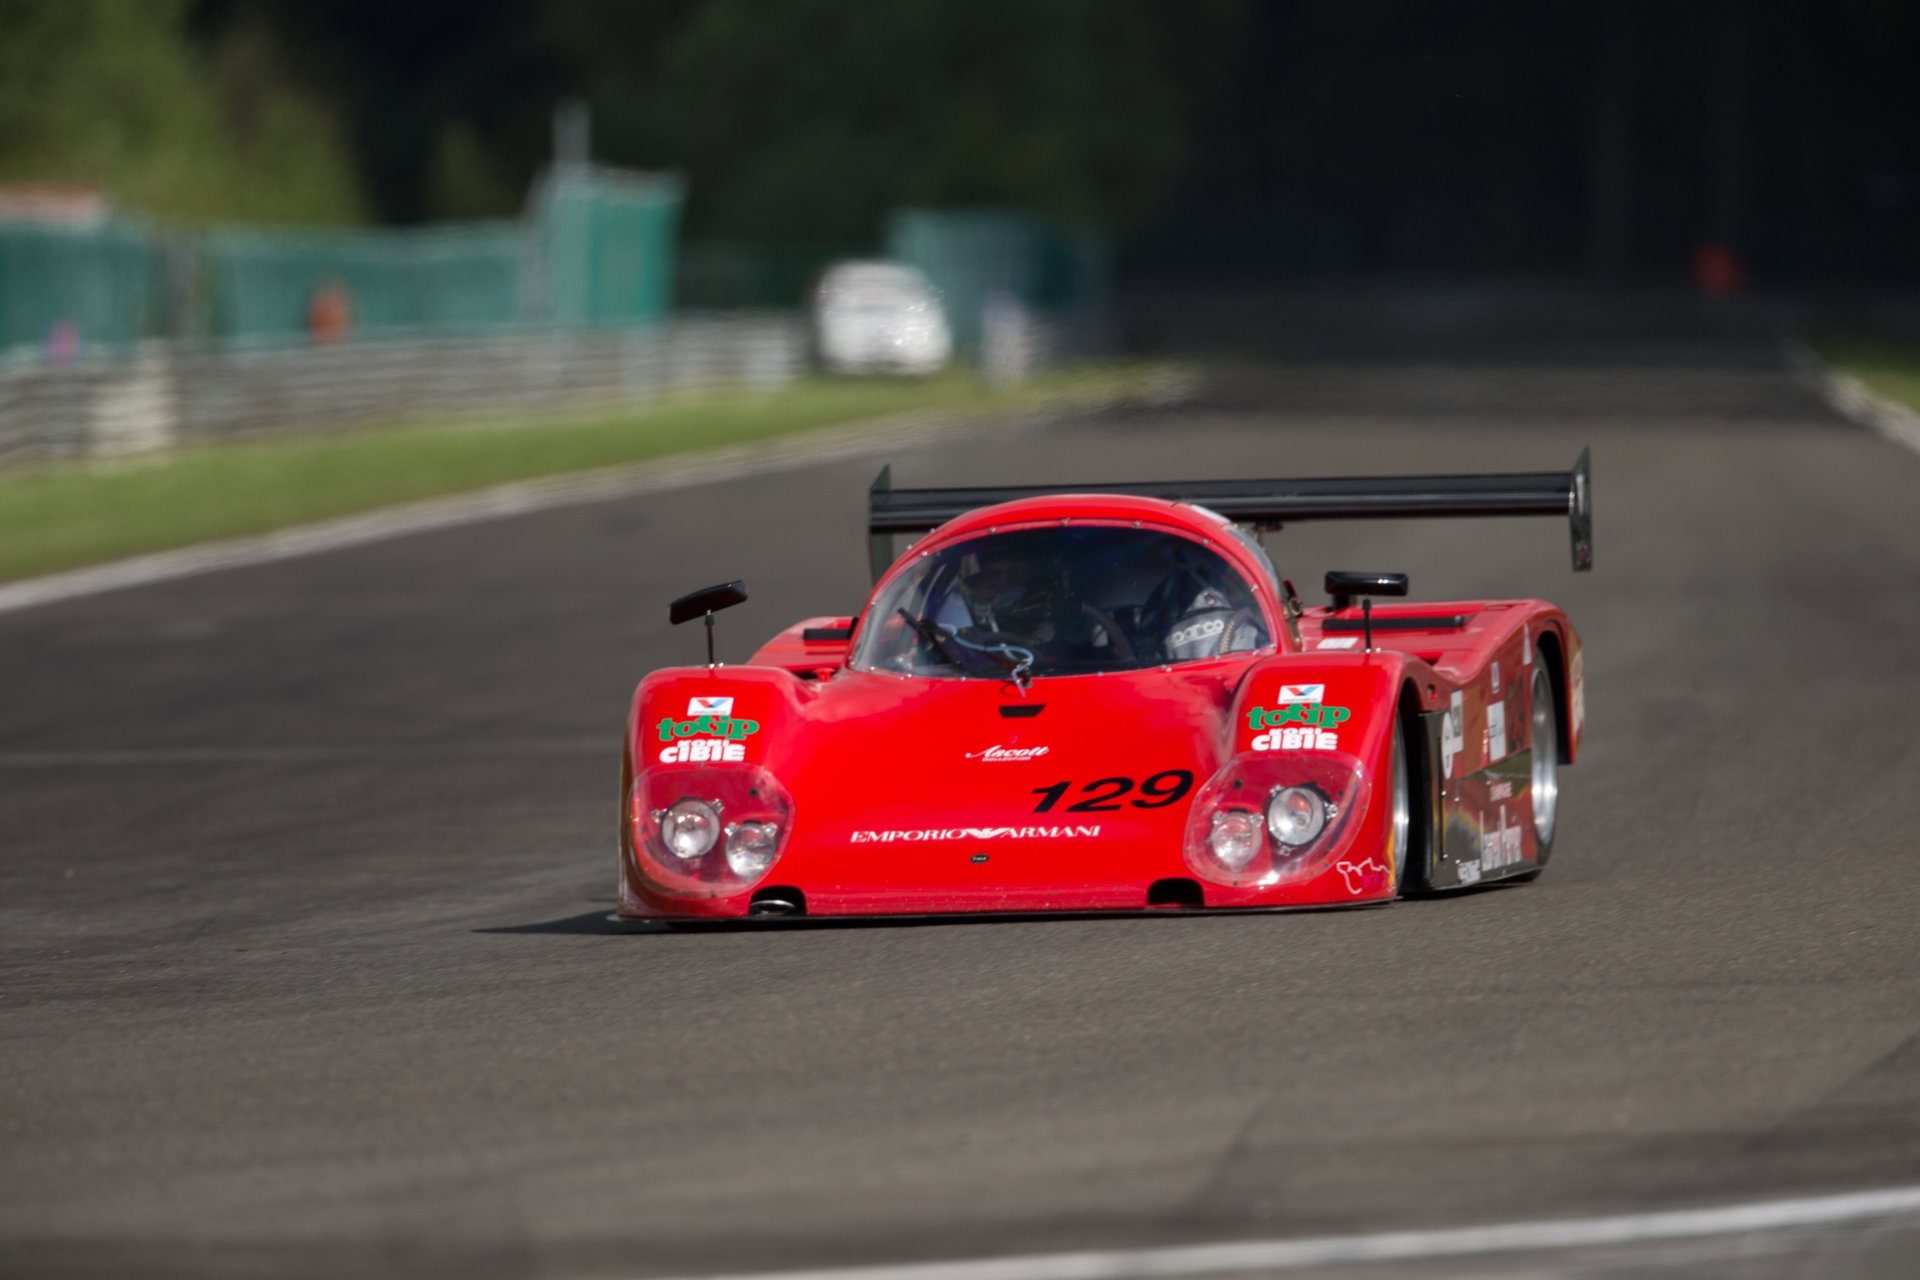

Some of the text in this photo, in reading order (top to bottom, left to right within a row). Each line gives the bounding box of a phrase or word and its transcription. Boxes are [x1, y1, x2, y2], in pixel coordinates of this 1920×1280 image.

[1246, 702, 1351, 730] totip
[656, 715, 760, 741] totip
[659, 743, 745, 763] CIBIE
[1251, 732, 1338, 751] CIBIE
[1031, 769, 1194, 813] 129
[850, 825, 1101, 843] EMPORIO ARMANI
